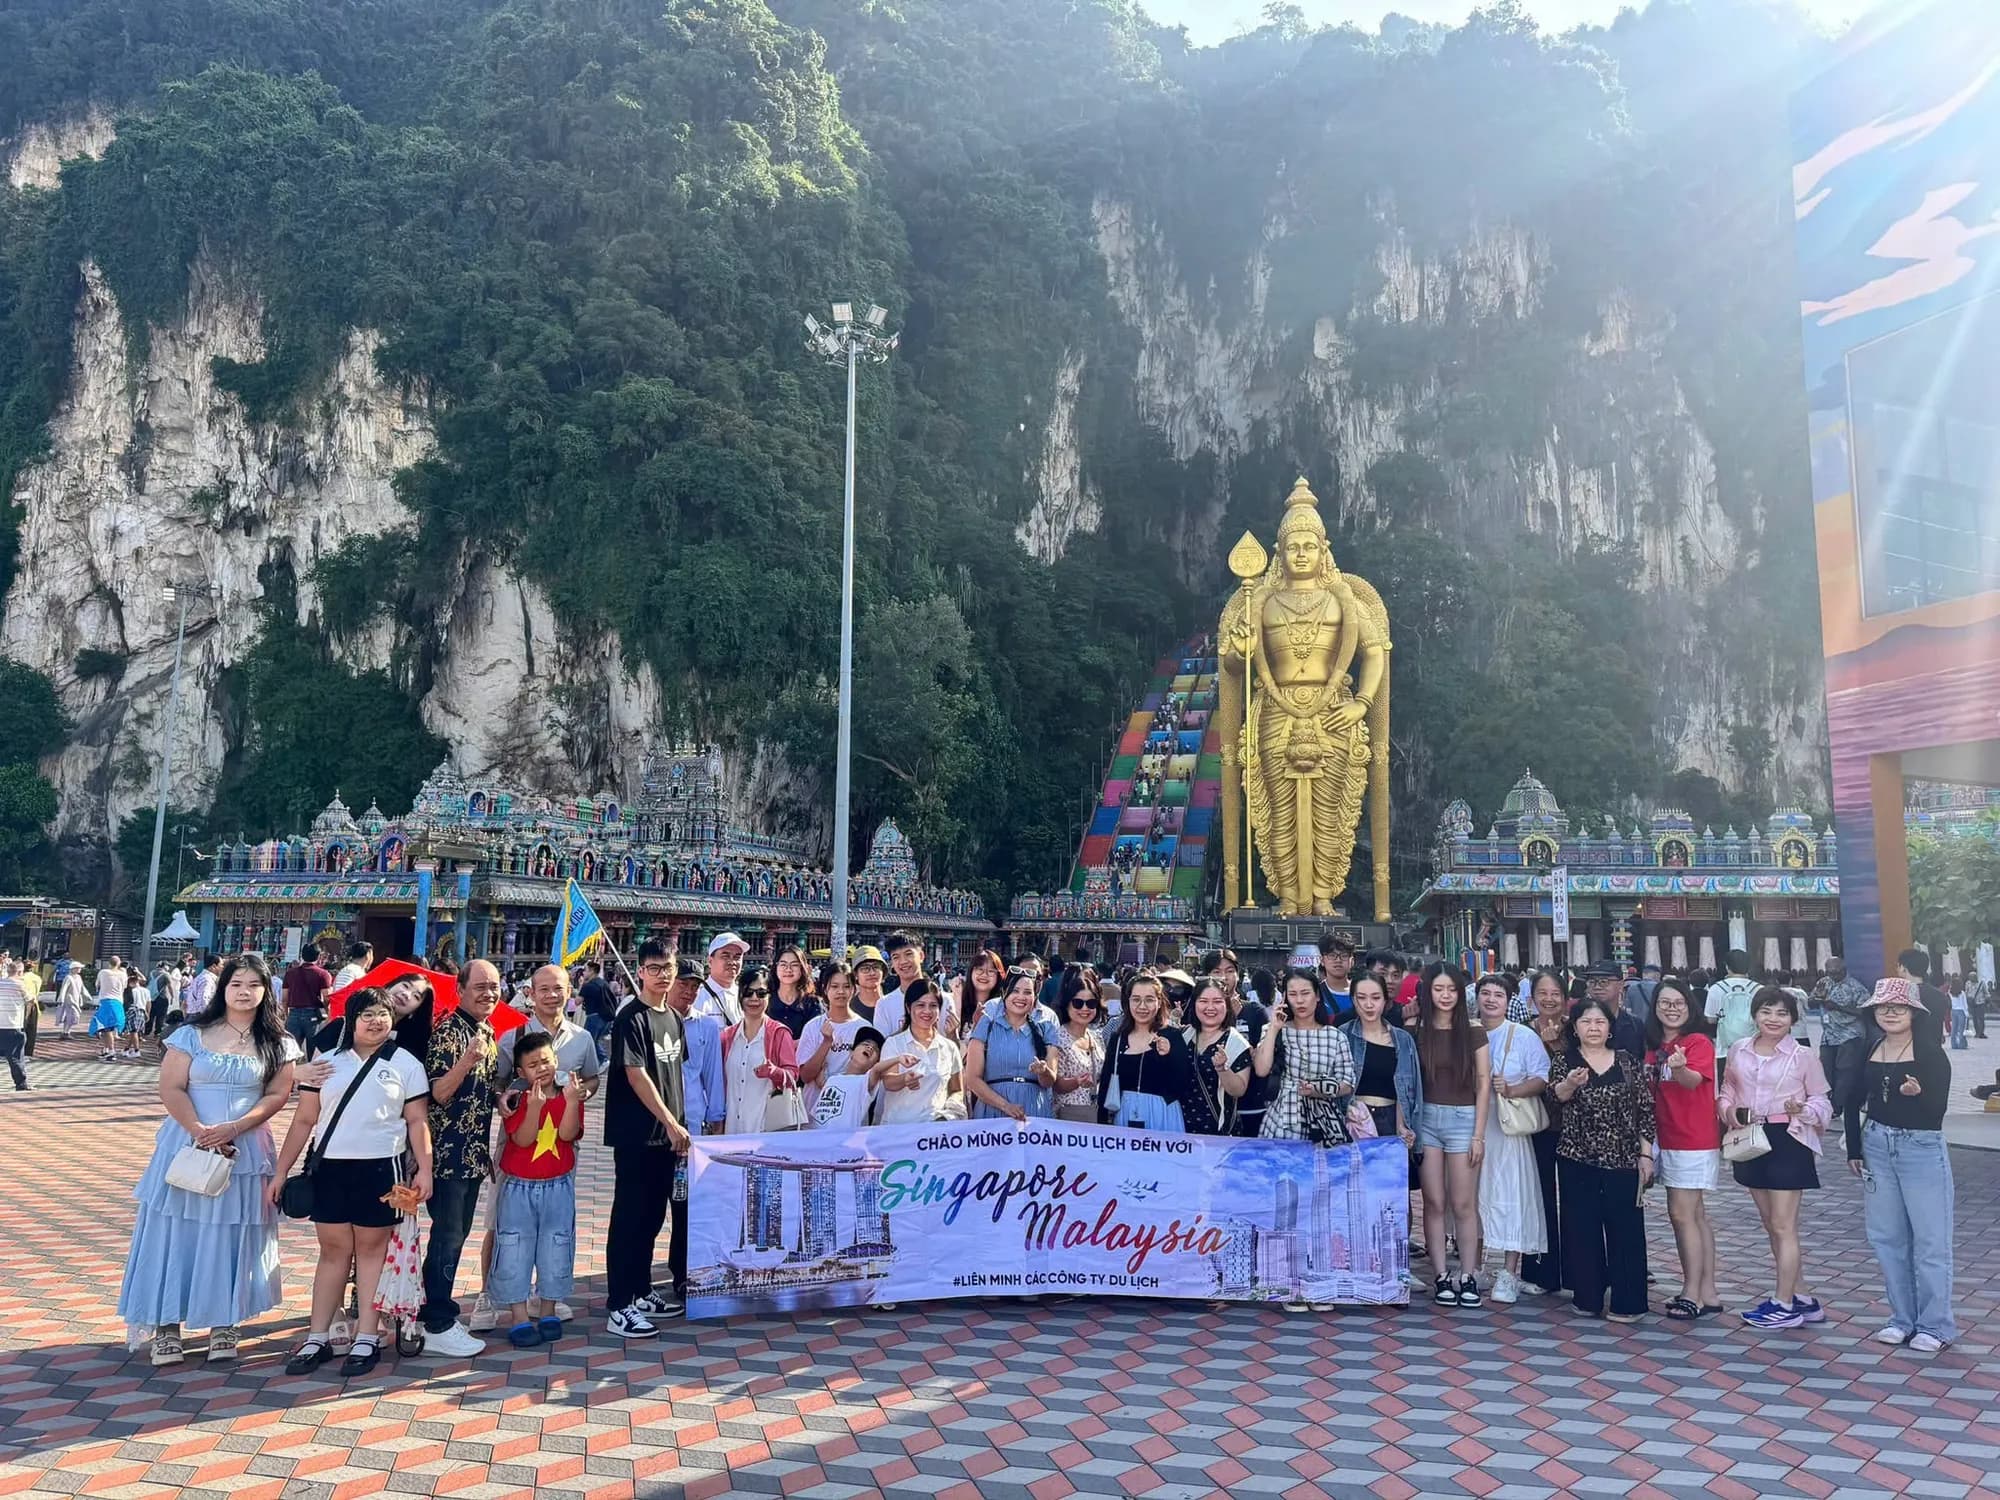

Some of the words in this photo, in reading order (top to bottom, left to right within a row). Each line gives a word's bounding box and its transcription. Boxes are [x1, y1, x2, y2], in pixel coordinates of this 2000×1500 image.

[917, 1133, 963, 1151] CHÀO
[967, 1130, 1014, 1148] MỪNG
[1018, 1129, 1063, 1147] ĐOÀN
[1067, 1134, 1088, 1148] DU
[1092, 1136, 1126, 1153] LỊCH
[1130, 1137, 1161, 1153] ĐẾN
[1165, 1140, 1193, 1154] VỚI
[879, 1159, 1098, 1226] Singapore
[1018, 1198, 1232, 1275] Malaysia
[953, 1271, 987, 1287] #LIÊN
[989, 1274, 1022, 1286] MINH
[1025, 1270, 1047, 1285] CÁC
[1047, 1270, 1087, 1285] CÔNG
[1090, 1273, 1106, 1285] TY
[1109, 1275, 1127, 1286] DU
[1130, 1276, 1159, 1290] LỊCH
